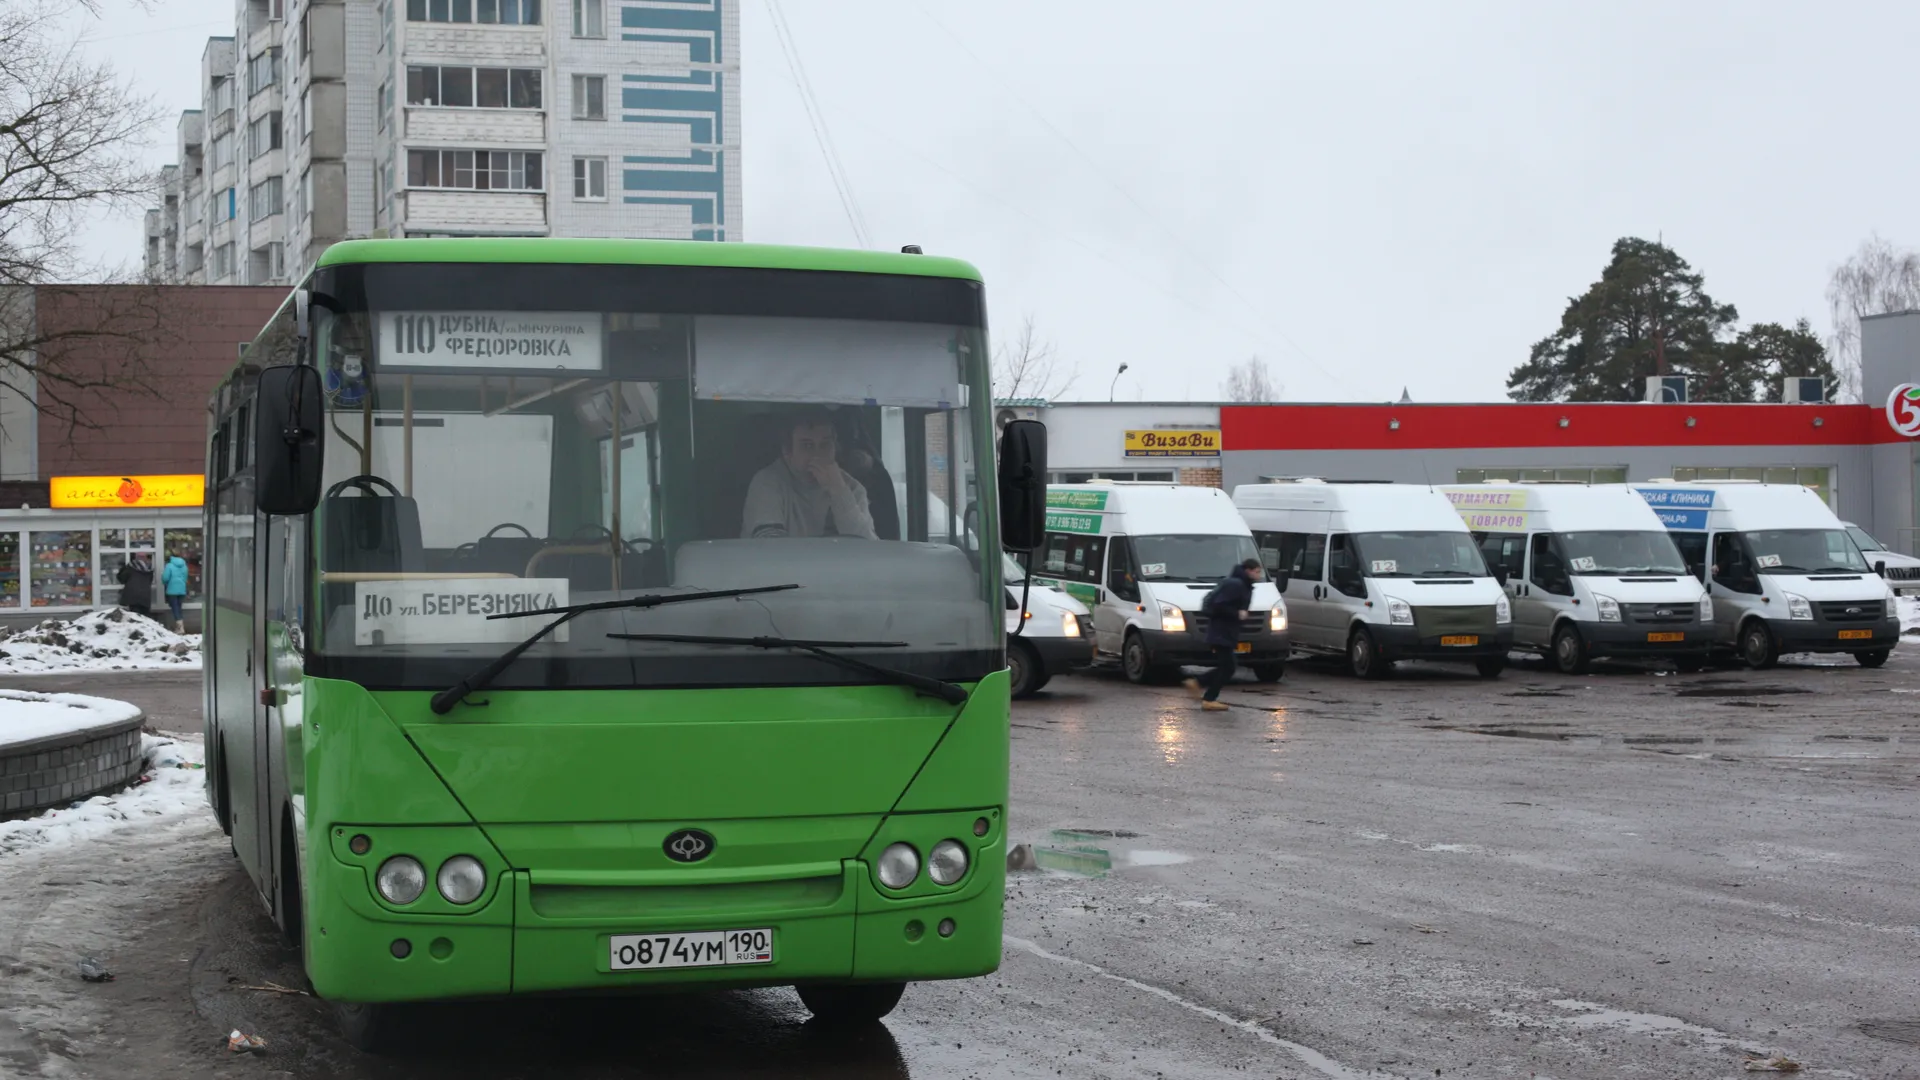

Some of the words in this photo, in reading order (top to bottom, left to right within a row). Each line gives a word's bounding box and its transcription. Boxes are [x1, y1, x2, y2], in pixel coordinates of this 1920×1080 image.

[394, 315, 435, 354] 110
[445, 337, 571, 357] ФЕДОРОВКА
[1141, 433, 1214, 447] ВизаВи
[1670, 494, 1710, 504] КЛИНИКА
[1470, 515, 1523, 527] ТОВАРОВ
[1374, 562, 1394, 571] 12
[1573, 558, 1594, 570] 12
[1759, 556, 1780, 567] 12
[1143, 565, 1164, 574] 12
[364, 595, 392, 620] ДО
[729, 932, 765, 952] 190
[737, 952, 755, 960] RUS
